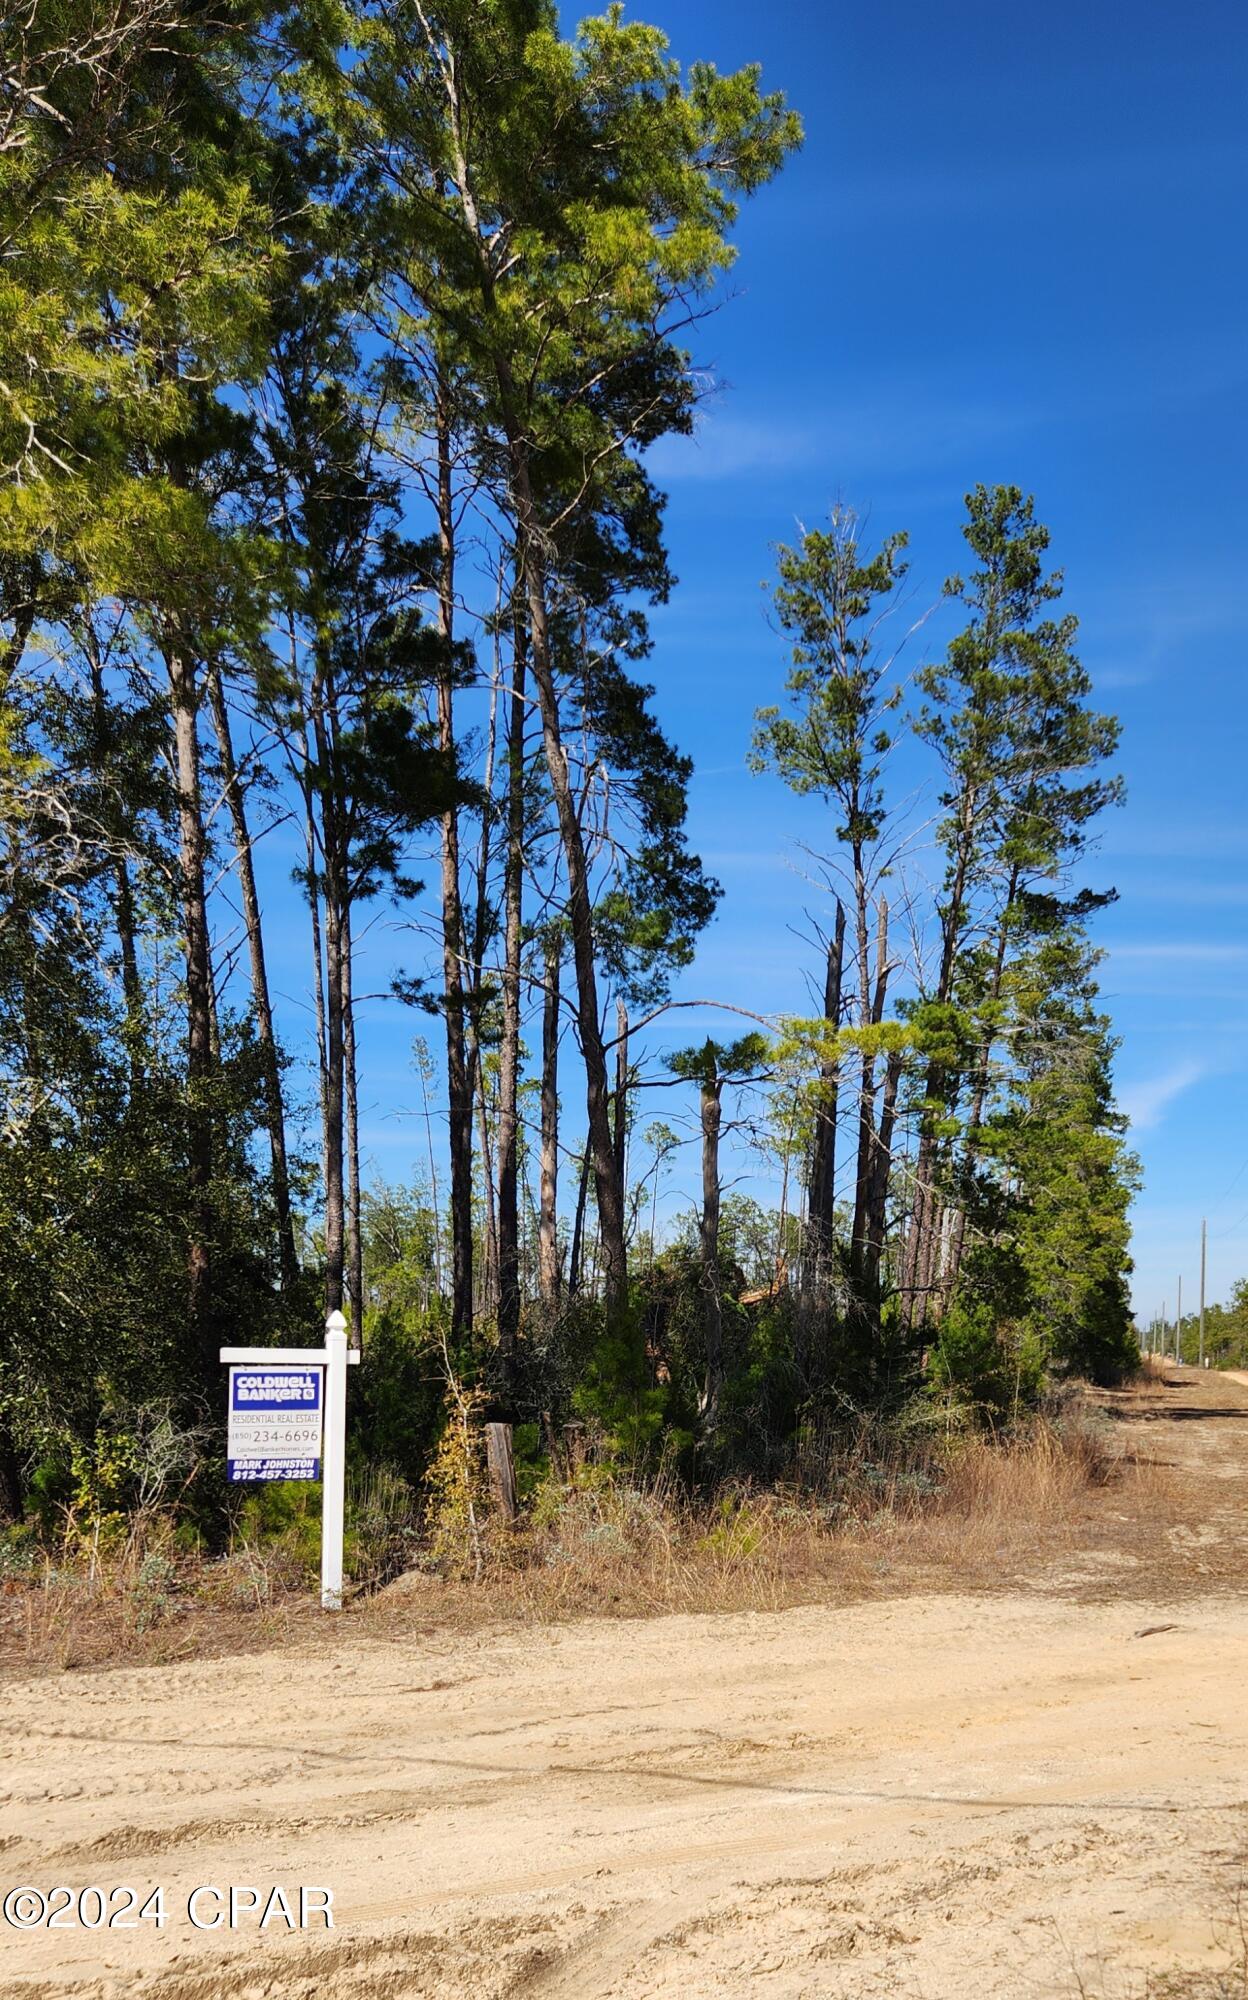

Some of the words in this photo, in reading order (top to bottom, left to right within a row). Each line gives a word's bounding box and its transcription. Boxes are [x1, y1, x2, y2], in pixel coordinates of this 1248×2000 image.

[237, 1376, 315, 1388] COLDWELL
[237, 1388, 302, 1402] BANKER
[233, 1415, 274, 1424] RESIDENTIAL
[278, 1415, 293, 1423] REAL
[296, 1415, 320, 1423] ESTATE
[253, 1430, 318, 1442] 234-6696
[233, 1460, 262, 1470] MARK
[263, 1459, 315, 1469] JOHNSTON
[232, 1469, 315, 1480] 812-457-3252
